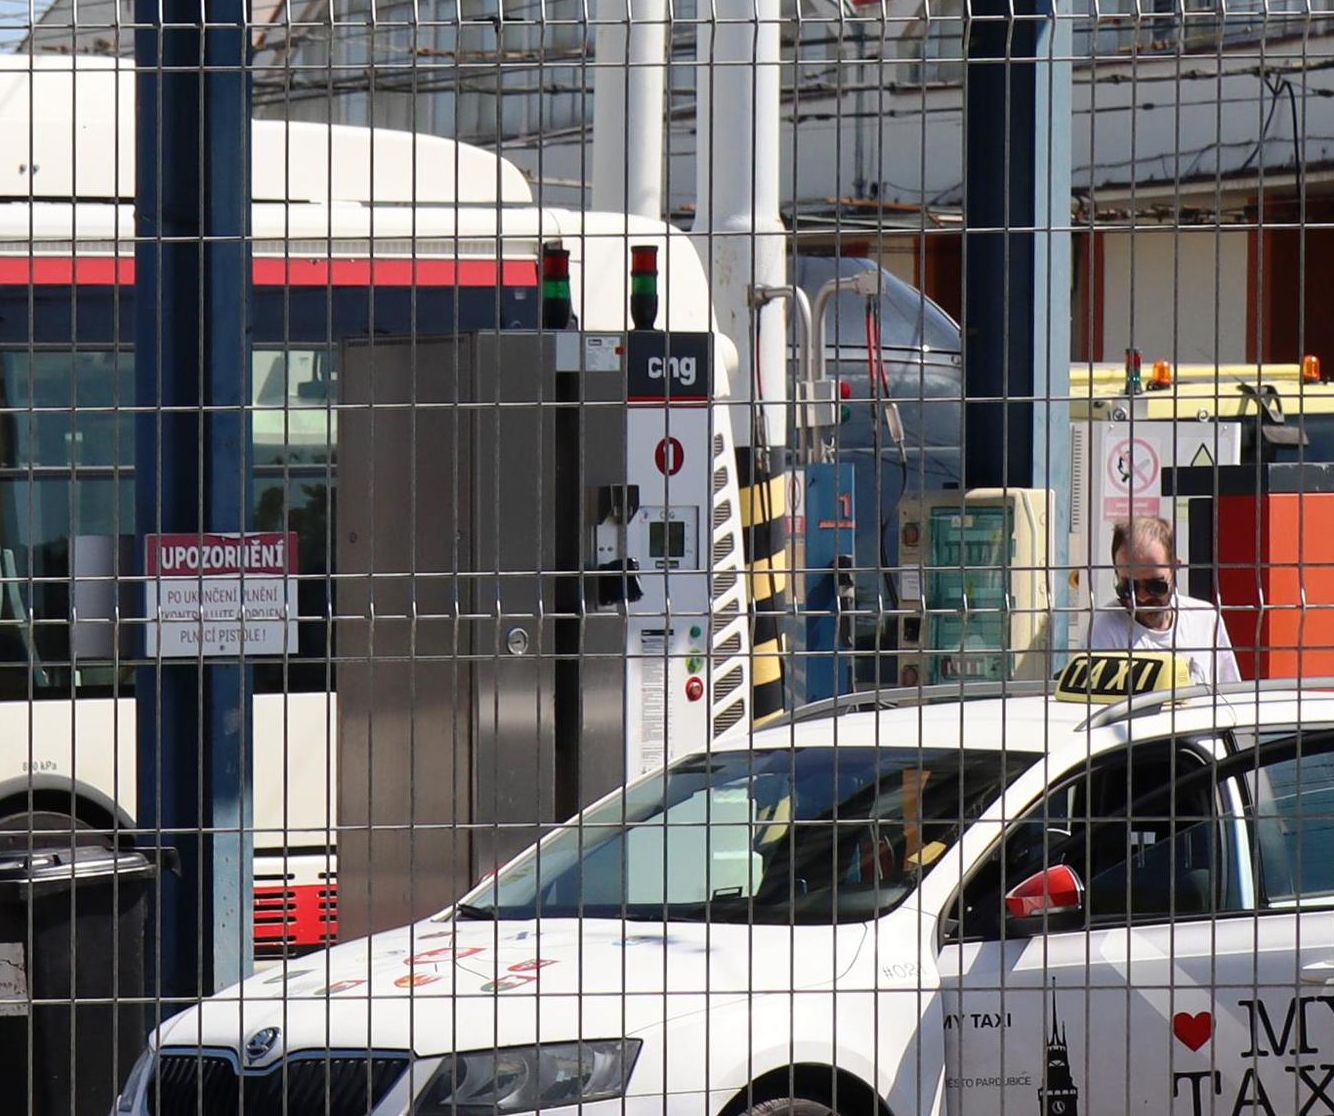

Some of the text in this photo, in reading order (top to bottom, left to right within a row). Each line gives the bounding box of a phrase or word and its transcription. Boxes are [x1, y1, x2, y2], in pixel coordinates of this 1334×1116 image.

[648, 356, 696, 386] cng
[662, 443, 674, 470] 1
[659, 511, 675, 519] CG
[161, 539, 284, 570] UPOZORNĚNÍ
[167, 590, 181, 605] PO
[184, 587, 238, 605] UKNČENÍ
[180, 627, 215, 643] PLNCÍ
[1068, 658, 1155, 691] TAXI
[970, 1012, 1011, 1028] TAXI
